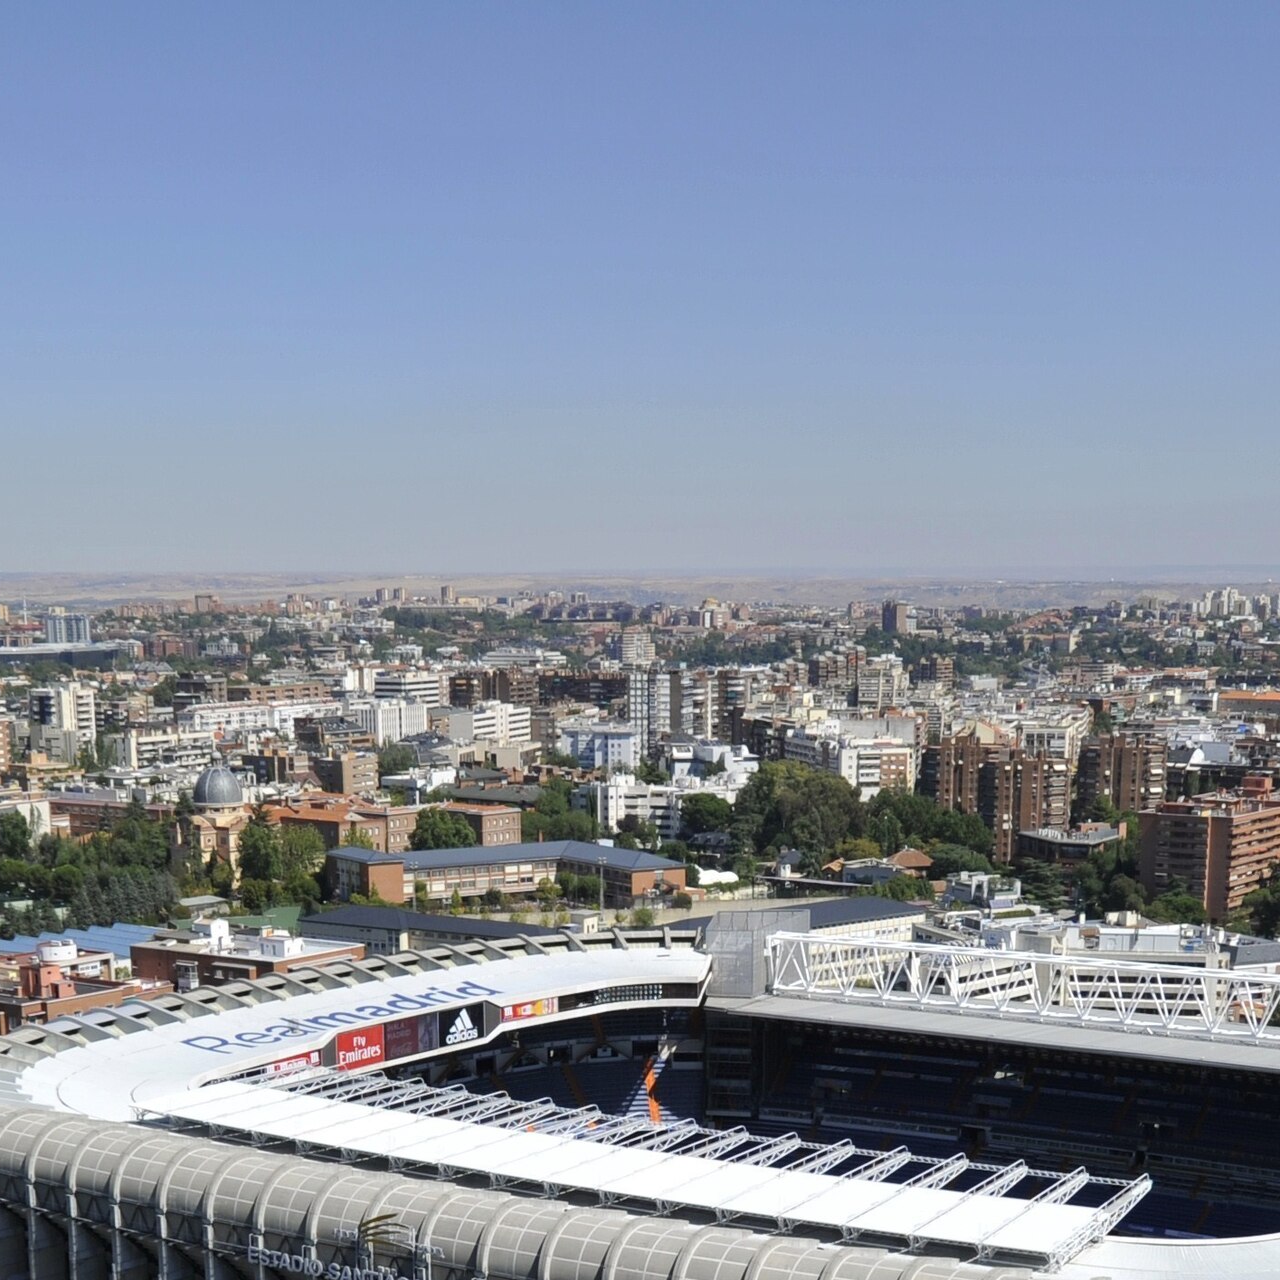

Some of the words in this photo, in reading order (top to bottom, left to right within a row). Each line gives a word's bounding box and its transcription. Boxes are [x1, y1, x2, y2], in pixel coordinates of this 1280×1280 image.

[180, 980, 504, 1055] Realmadrid
[352, 1036, 366, 1047] Fly
[445, 1027, 479, 1046] adidas
[339, 1045, 382, 1066] Emirates
[247, 1247, 324, 1277] ESTADIO
